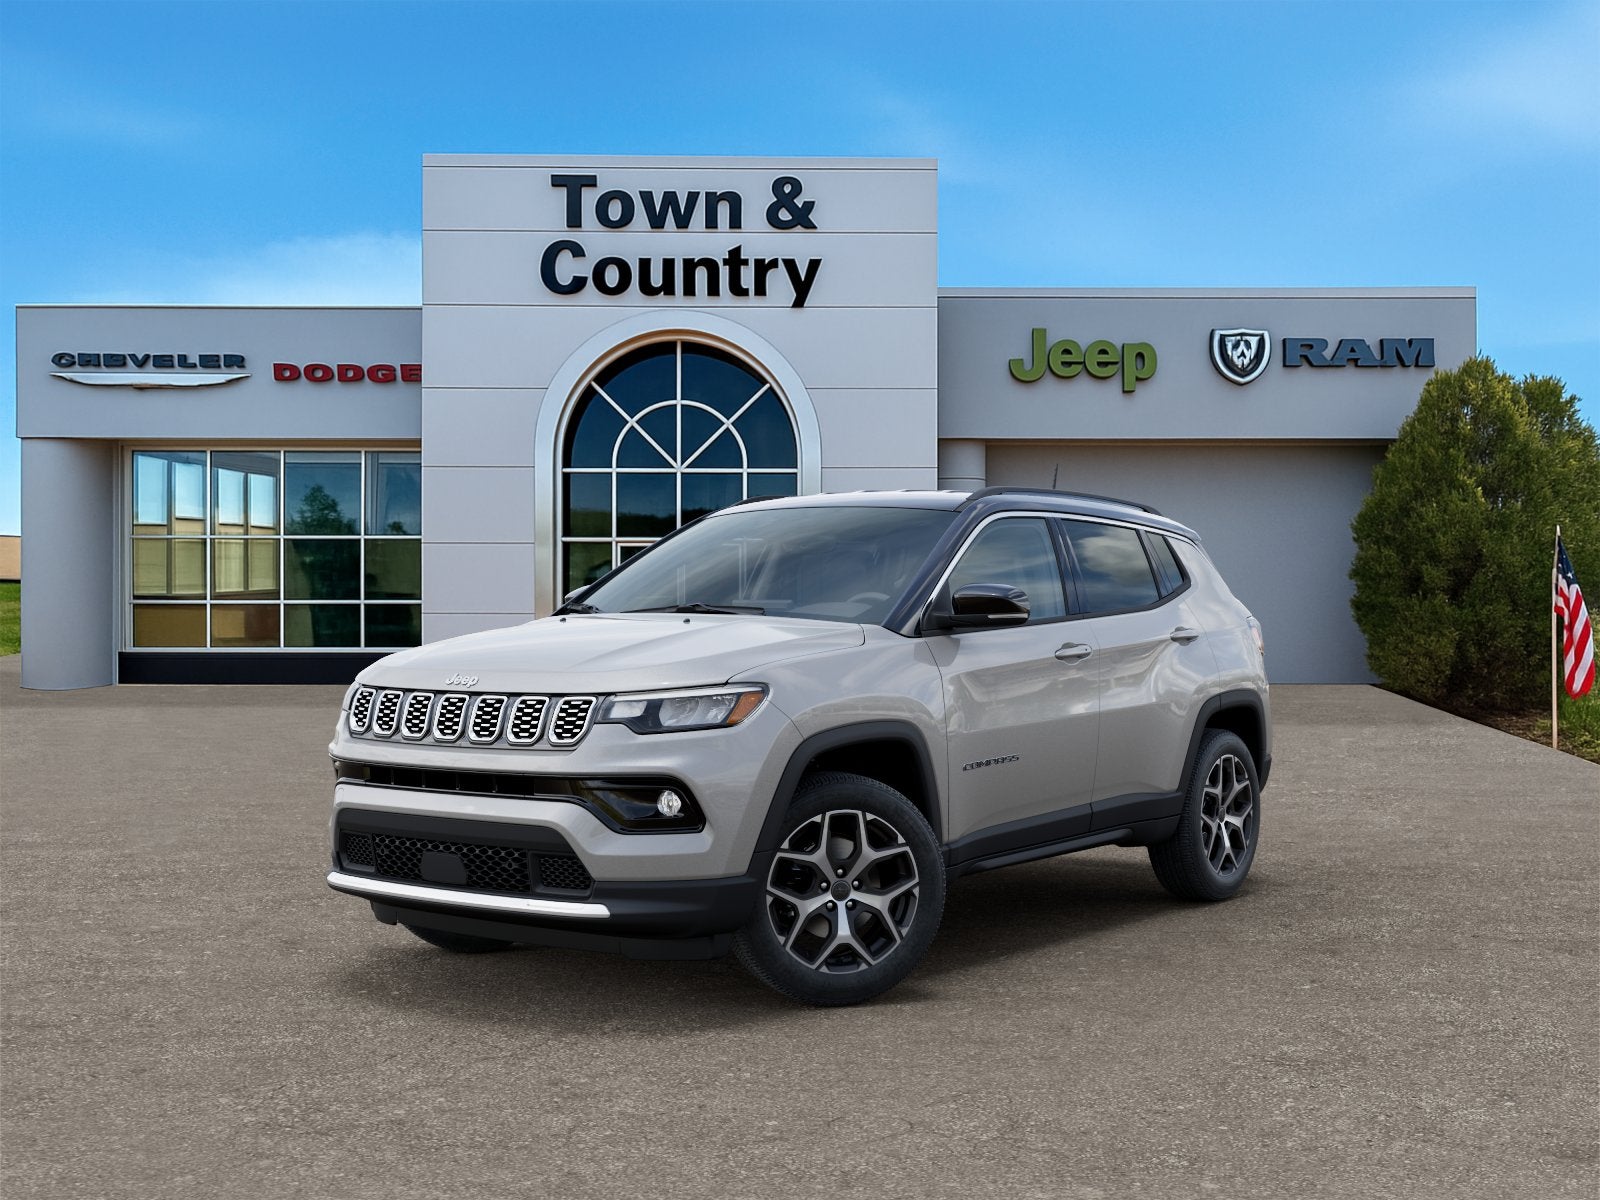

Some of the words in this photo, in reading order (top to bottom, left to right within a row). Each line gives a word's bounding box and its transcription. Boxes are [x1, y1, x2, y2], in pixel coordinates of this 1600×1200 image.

[550, 174, 742, 229] Town
[766, 176, 818, 230] &
[540, 239, 823, 308] Country
[1008, 327, 1158, 393] Jeep
[1282, 337, 1436, 367] RAM
[272, 362, 422, 383] DODGE
[445, 672, 480, 688] Jeep
[962, 754, 1020, 771] COMPASS
